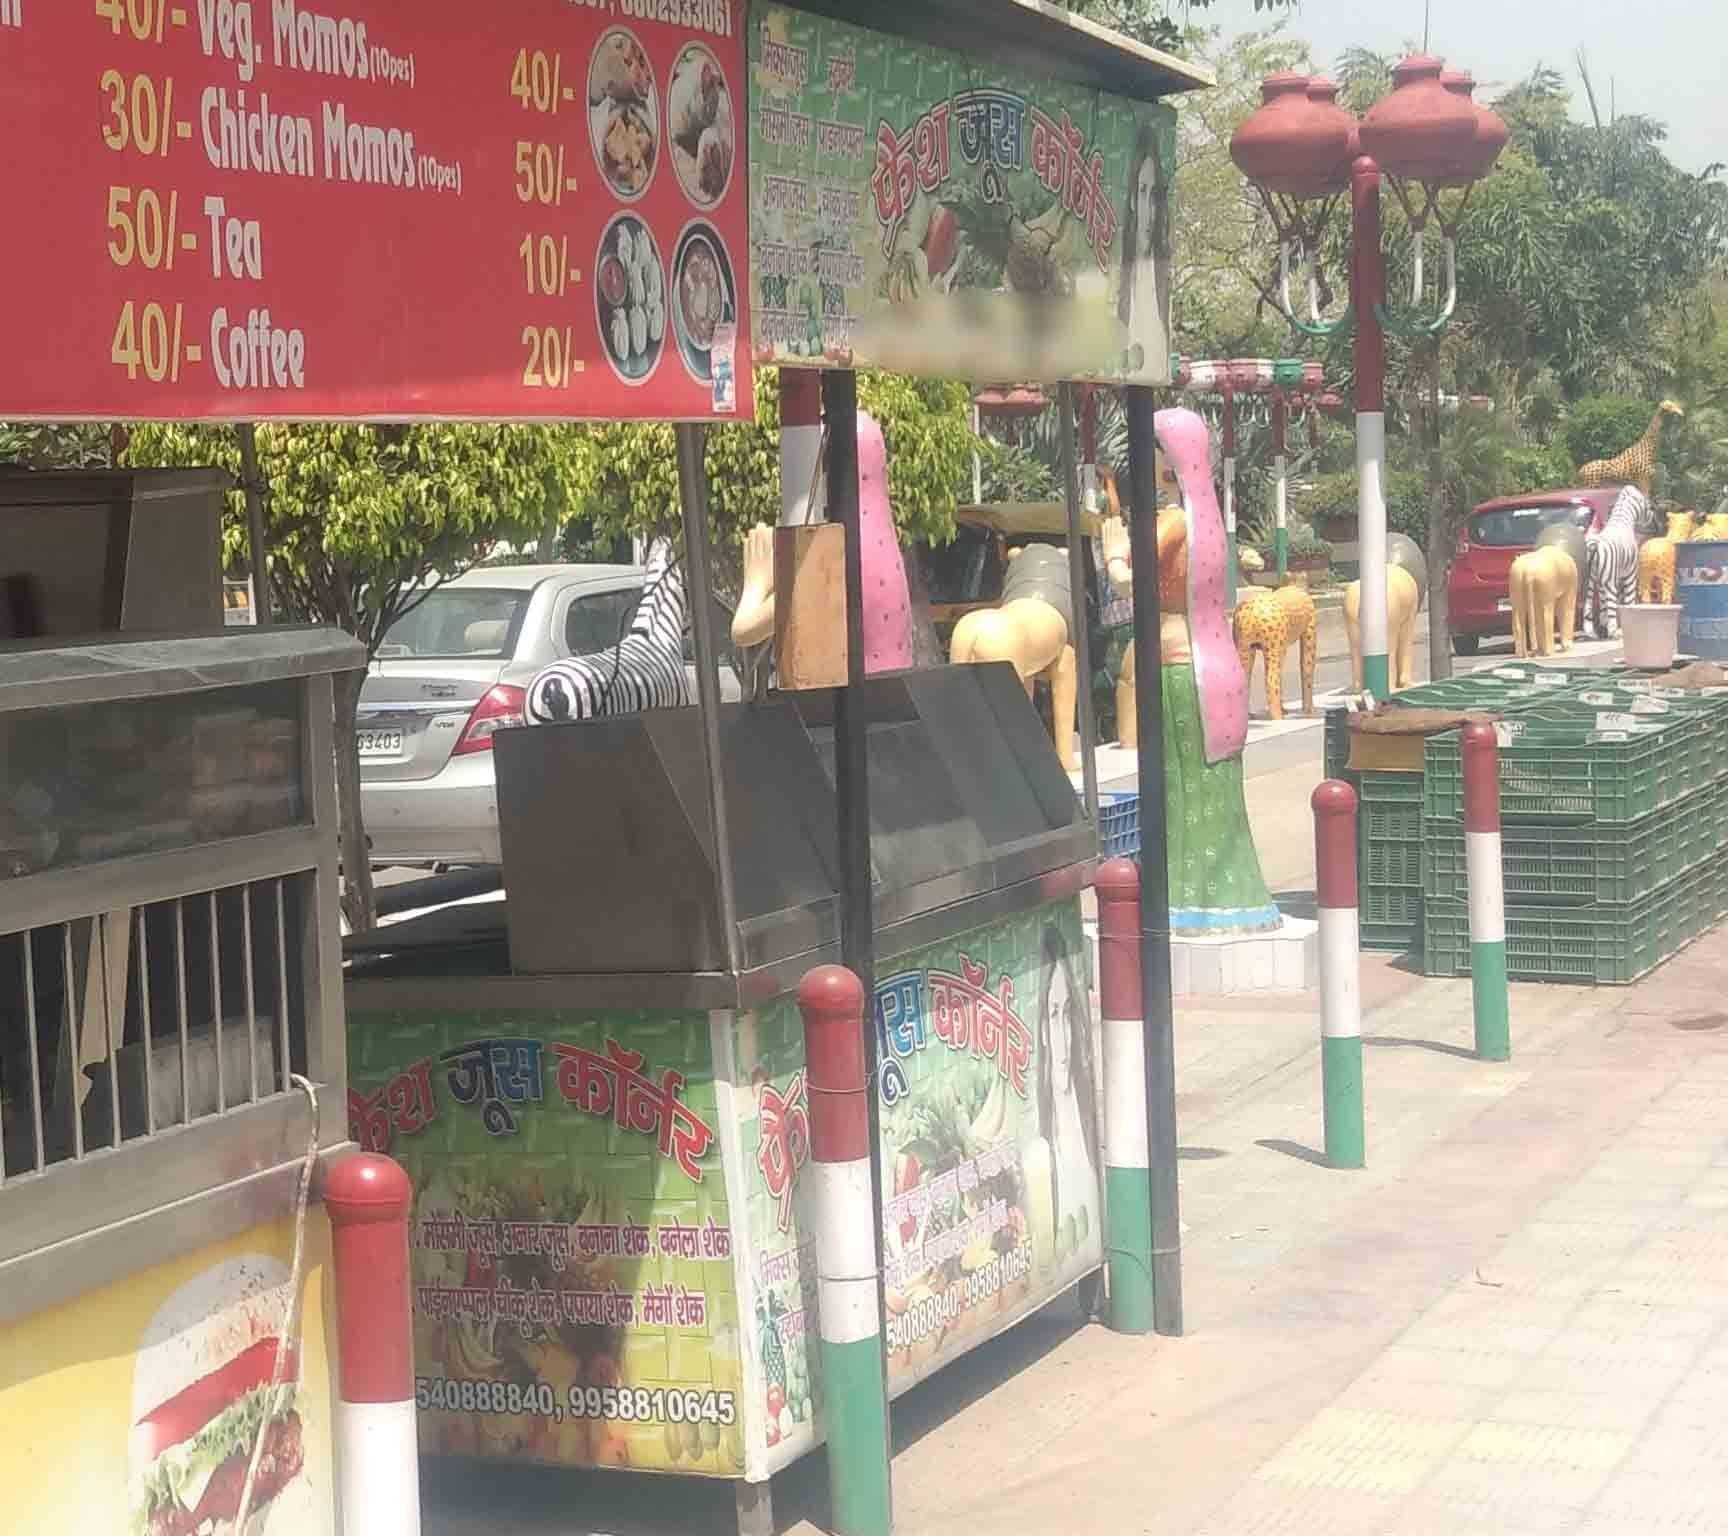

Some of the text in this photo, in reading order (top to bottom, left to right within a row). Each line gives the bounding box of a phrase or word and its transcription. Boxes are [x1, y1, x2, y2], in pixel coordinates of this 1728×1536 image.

[100, 69, 192, 158] 30/-
[510, 48, 576, 115] 40/-
[200, 84, 315, 180] Chicken
[514, 143, 578, 208] 50/-
[106, 185, 198, 271] 50/-
[203, 194, 582, 298] Tea 10/-
[110, 300, 202, 383] 40/-
[210, 307, 585, 390] Coffee 20/-
[439, 1037, 544, 1137] जूस
[415, 1377, 736, 1424] 540888840, 9958810645
